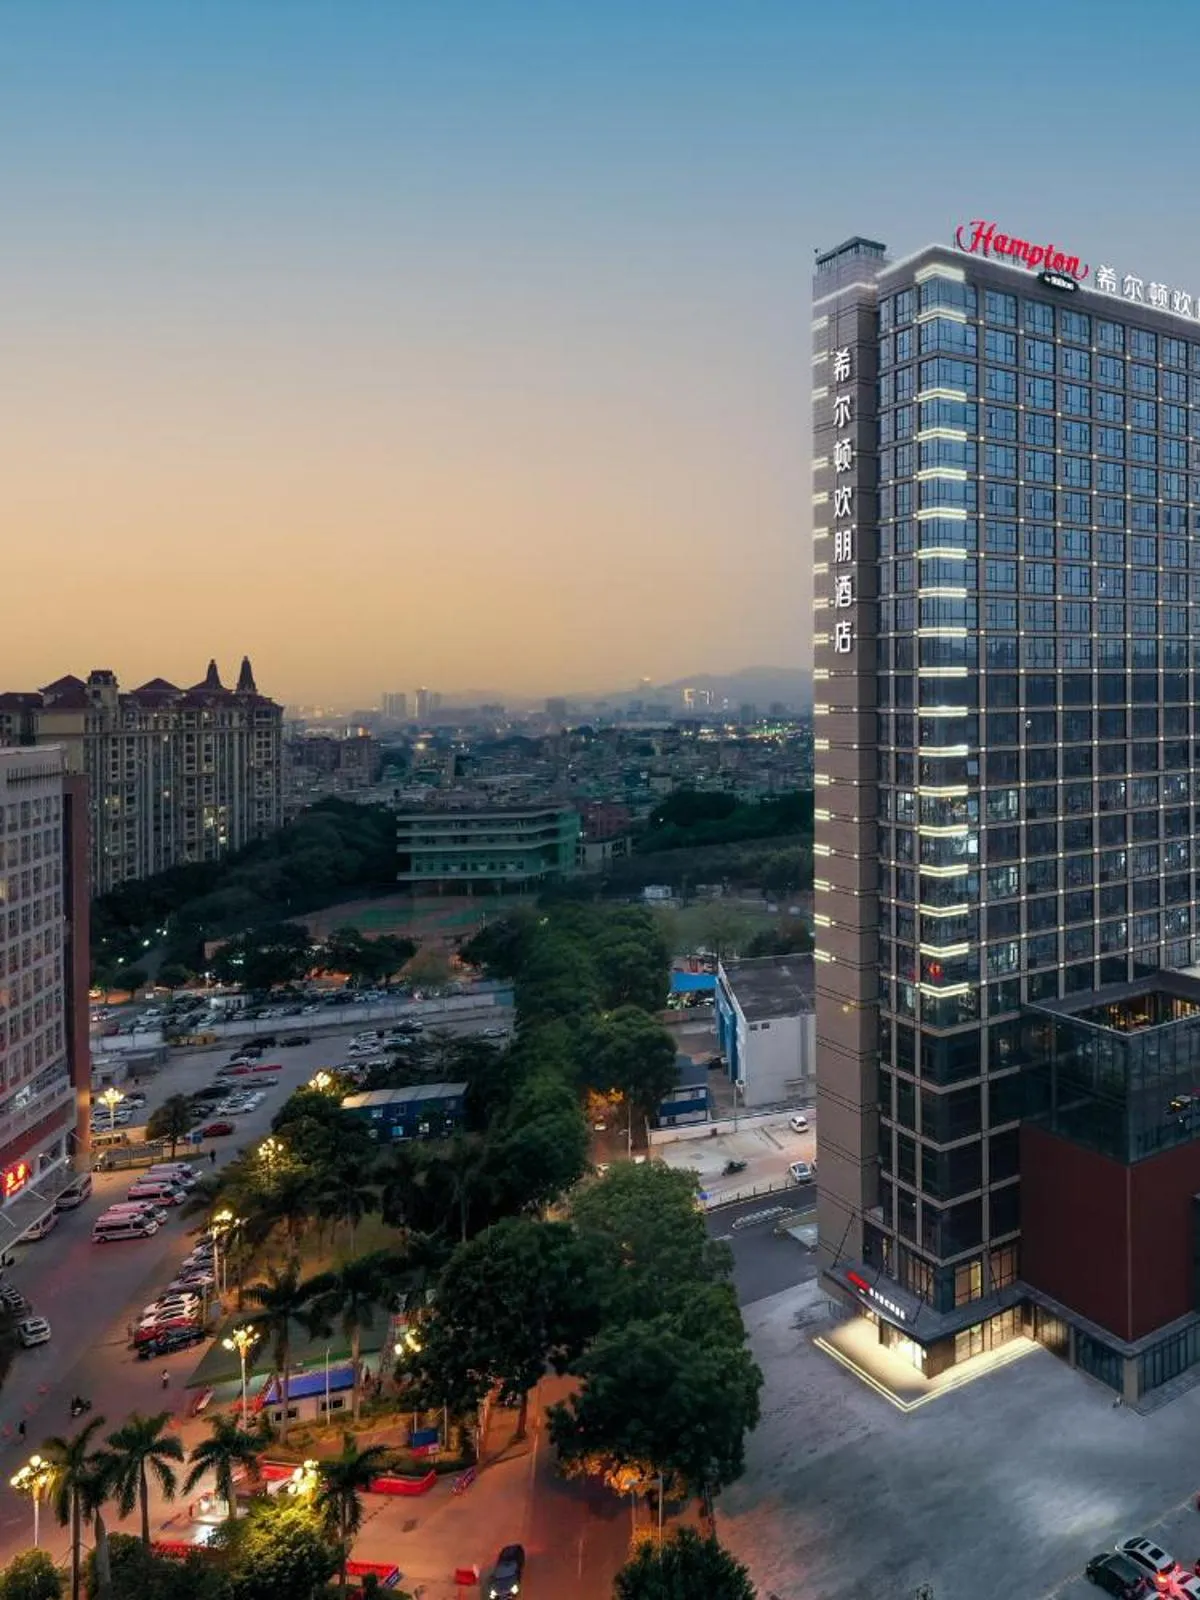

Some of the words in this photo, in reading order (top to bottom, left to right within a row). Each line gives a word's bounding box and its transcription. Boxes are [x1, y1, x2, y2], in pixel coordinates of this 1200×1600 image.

[956, 220, 1089, 280] Hampton
[833, 347, 852, 654] 希尔顿欢朋酒店
